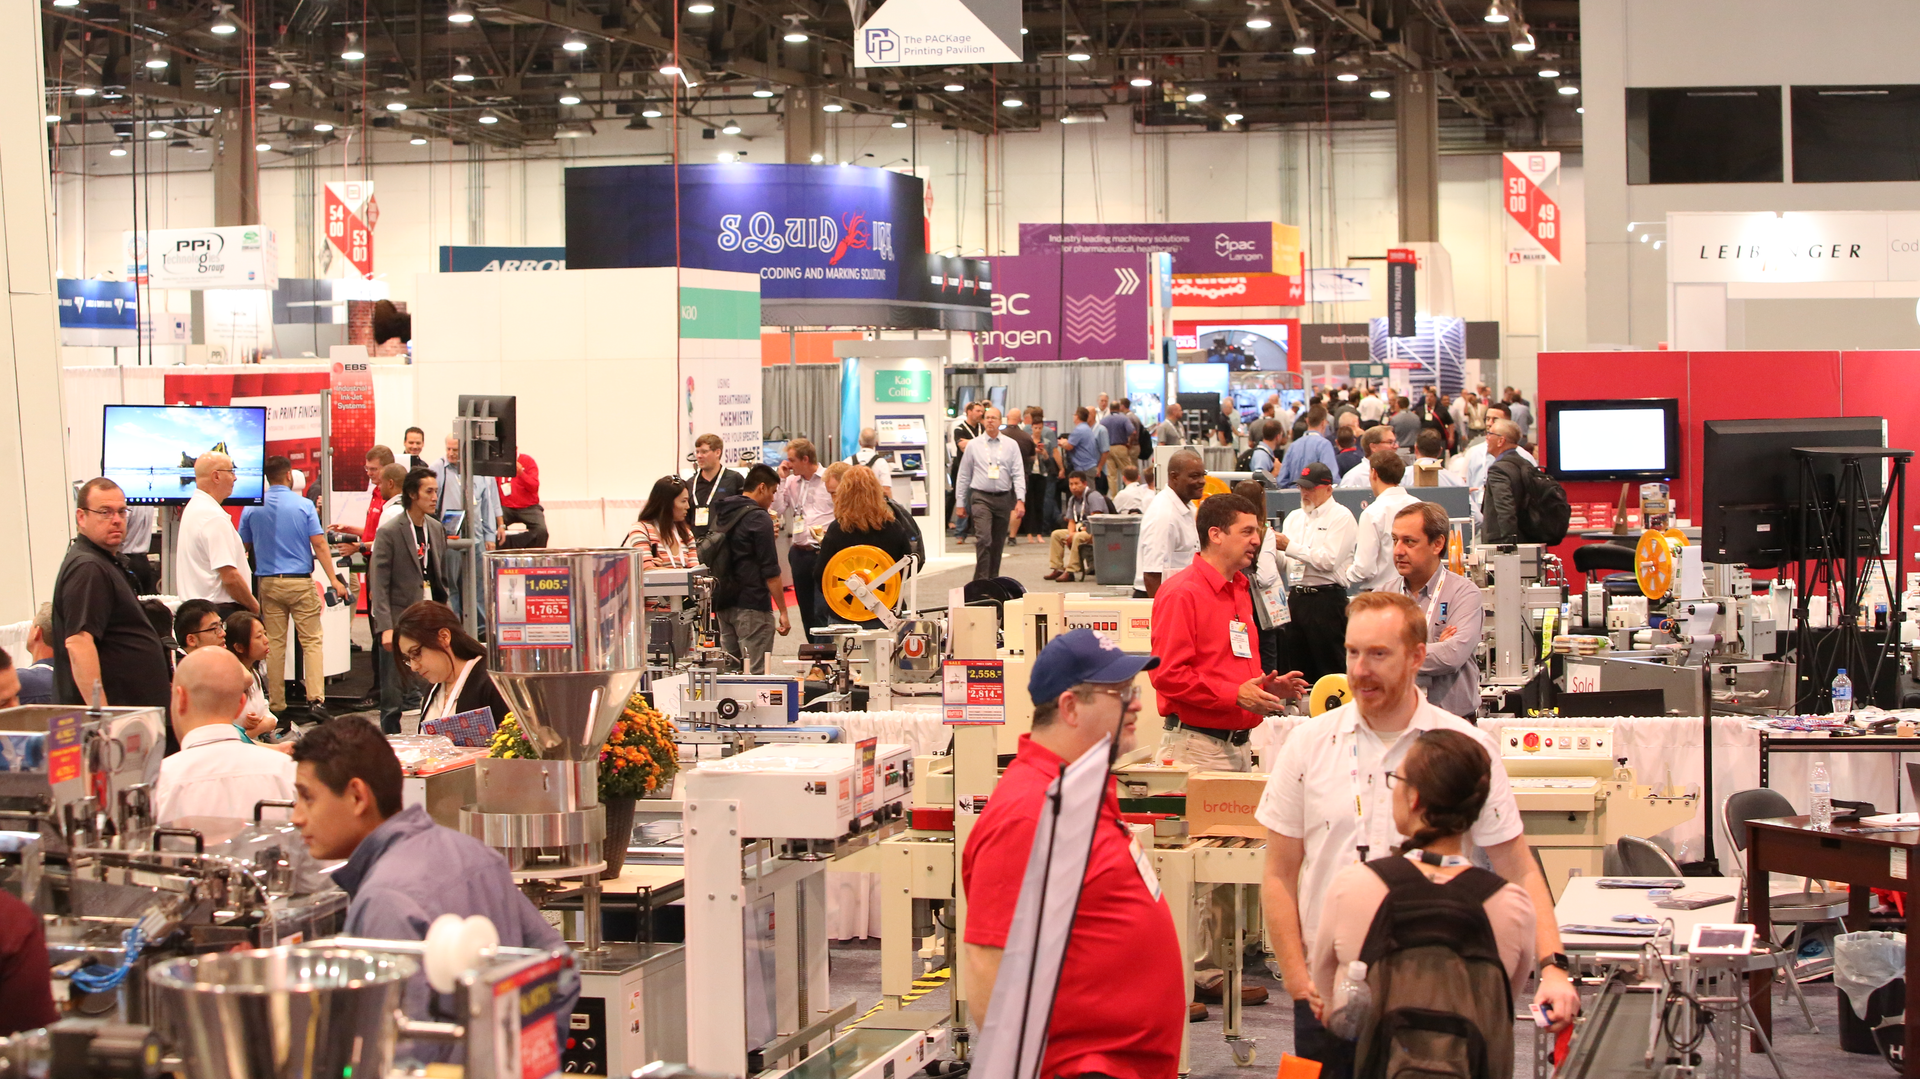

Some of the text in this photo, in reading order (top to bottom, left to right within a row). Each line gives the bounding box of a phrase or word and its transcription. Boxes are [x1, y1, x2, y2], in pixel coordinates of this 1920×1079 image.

[926, 34, 972, 45] PACKage
[904, 46, 985, 56] Printing Pavilion
[1510, 178, 1526, 194] 50
[1510, 196, 1526, 212] 00
[330, 204, 344, 220] 54
[1538, 204, 1555, 221] 49
[330, 222, 344, 238] 00
[718, 212, 838, 254] SQUID
[1538, 222, 1555, 239] 00
[353, 230, 367, 246] 53
[1049, 234, 1190, 244] Industry leading machinery solutions
[1216, 240, 1255, 252] Mpac
[163, 252, 220, 265] Technologies
[353, 246, 367, 262] 00
[1229, 252, 1264, 262] Langen
[760, 267, 886, 280] CODING AND MARKING SOLUTIONS
[973, 330, 1052, 350] angen
[718, 378, 730, 388] USING
[895, 376, 912, 385] Kao
[888, 388, 919, 397] Collins
[338, 402, 366, 410] Systems
[718, 394, 752, 406] BREAKTHROUGH
[279, 406, 297, 419] PRINT
[720, 410, 754, 427] CHEMISTRY
[722, 431, 760, 442] FOR YOUR SPECIFIC
[1572, 676, 1594, 692] Sold
[1204, 800, 1257, 814] brother
